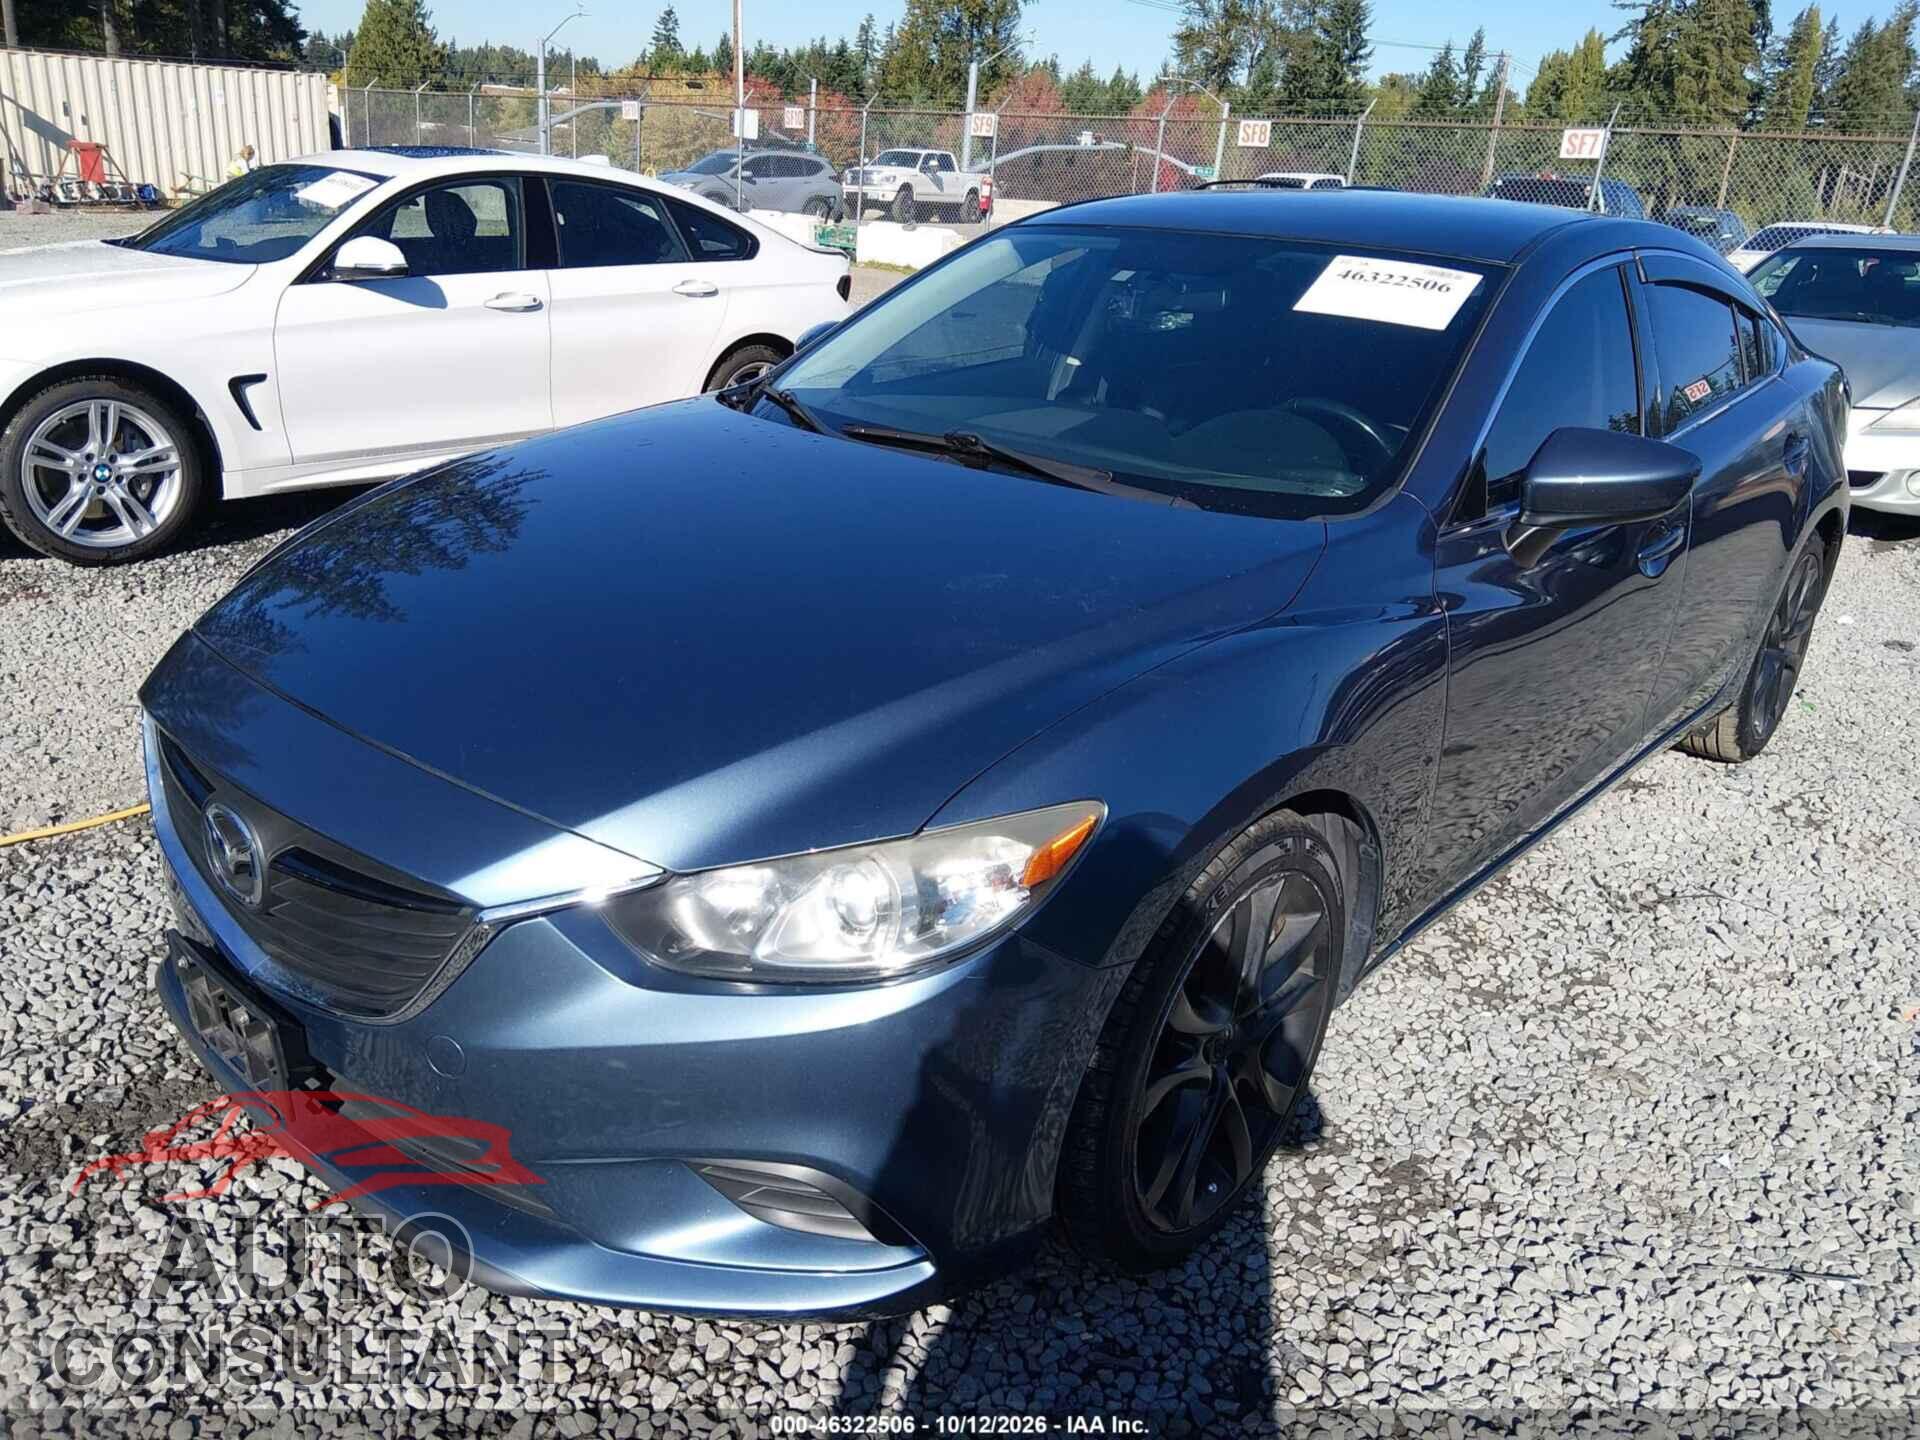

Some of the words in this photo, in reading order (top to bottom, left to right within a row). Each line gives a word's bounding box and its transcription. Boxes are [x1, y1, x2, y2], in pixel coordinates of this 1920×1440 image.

[972, 115, 993, 133] SF9
[1242, 123, 1268, 144] SF8
[1566, 132, 1600, 155] SF7
[1336, 269, 1452, 294] 46322506
